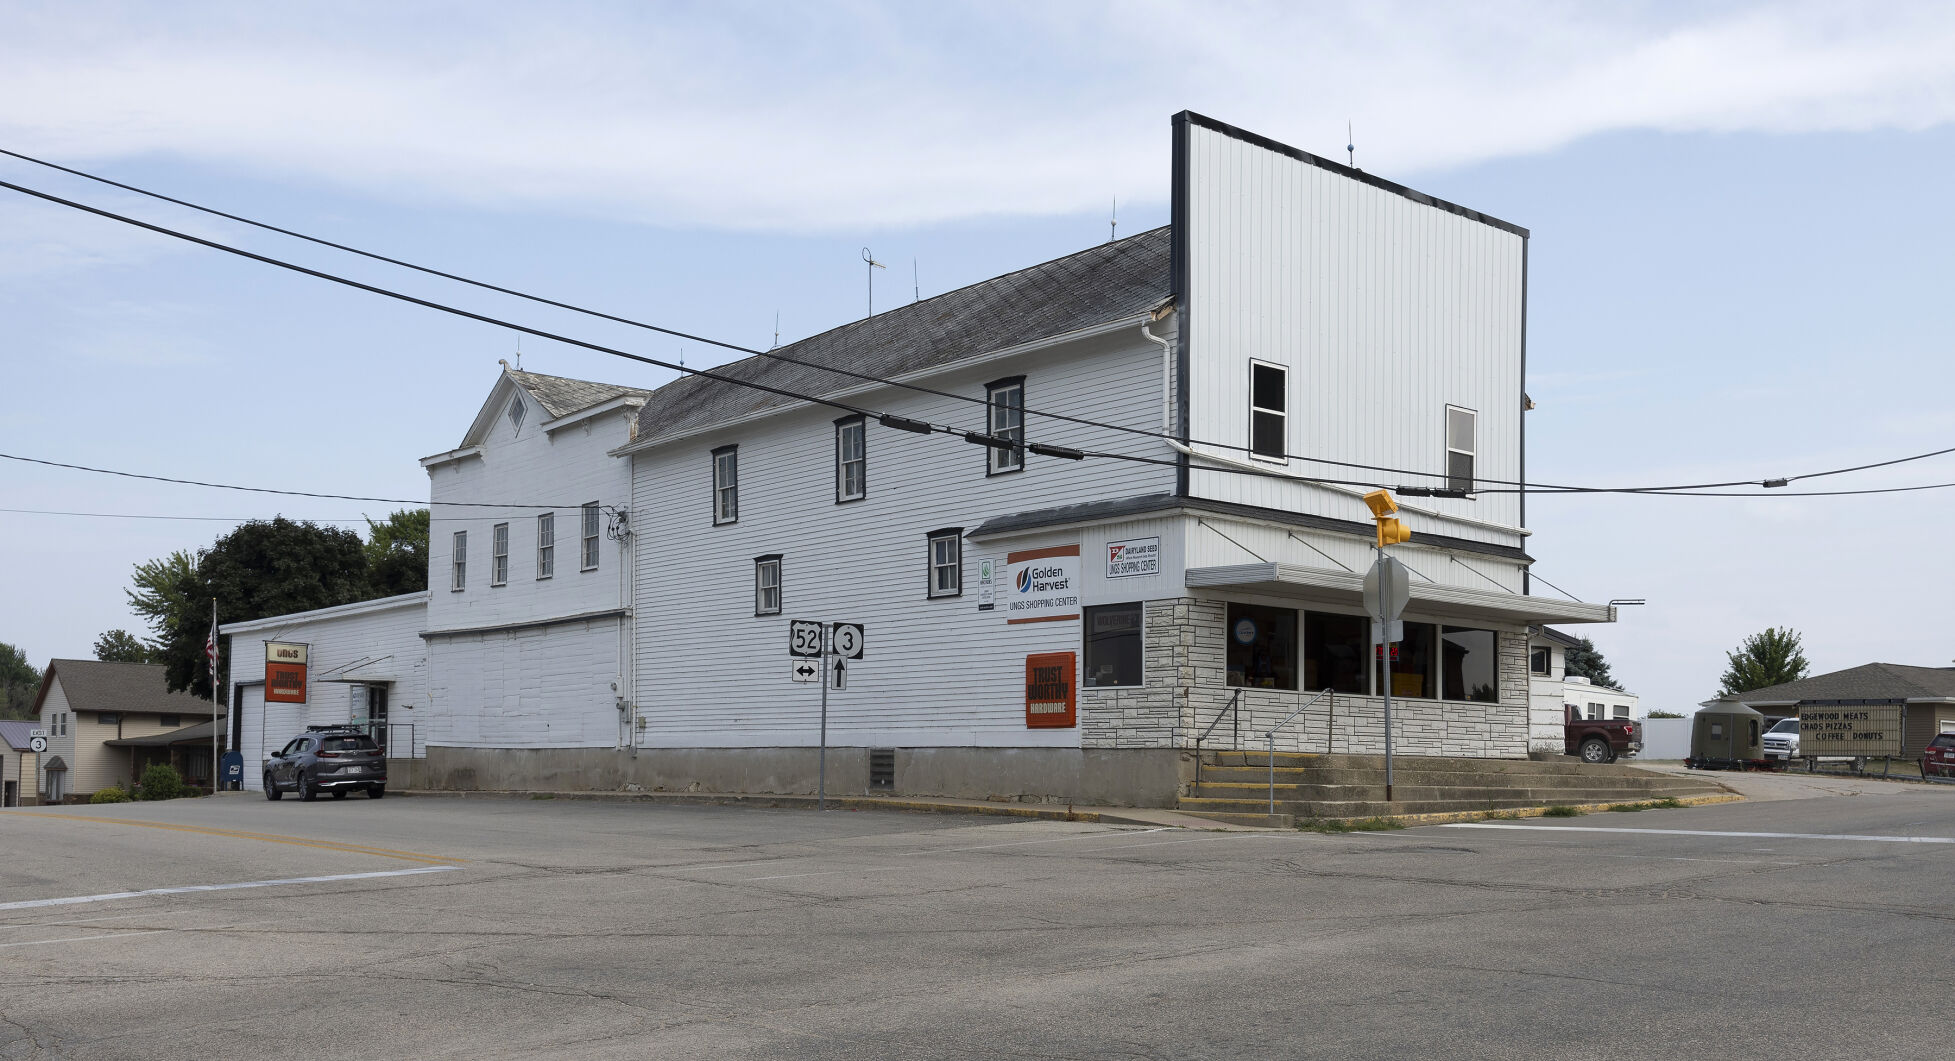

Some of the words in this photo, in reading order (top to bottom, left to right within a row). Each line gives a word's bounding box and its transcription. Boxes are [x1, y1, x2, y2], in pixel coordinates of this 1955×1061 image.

[1125, 546, 1146, 555] DAIRYLAND
[1147, 545, 1157, 553] SEED
[1032, 567, 1063, 579] Golden
[1121, 560, 1140, 574] SHOPPING
[1141, 559, 1156, 571] CENTER
[1032, 578, 1069, 592] Harvest
[1009, 601, 1025, 611] UNGS
[1026, 599, 1054, 610] SHOPPING
[1055, 596, 1078, 607] CENTER
[796, 629, 817, 649] 52
[842, 632, 853, 650] 3
[1033, 666, 1063, 684] TRUST
[1028, 682, 1069, 700] WORTHY
[1030, 702, 1066, 714] HARDWARE
[1843, 712, 1869, 720] MEATS
[1801, 722, 1824, 730] CHADS
[1825, 722, 1853, 730] PIZZAS
[1816, 732, 1845, 740] COFFEE
[1852, 732, 1883, 740] DONUTS
[35, 740, 42, 749] 3
